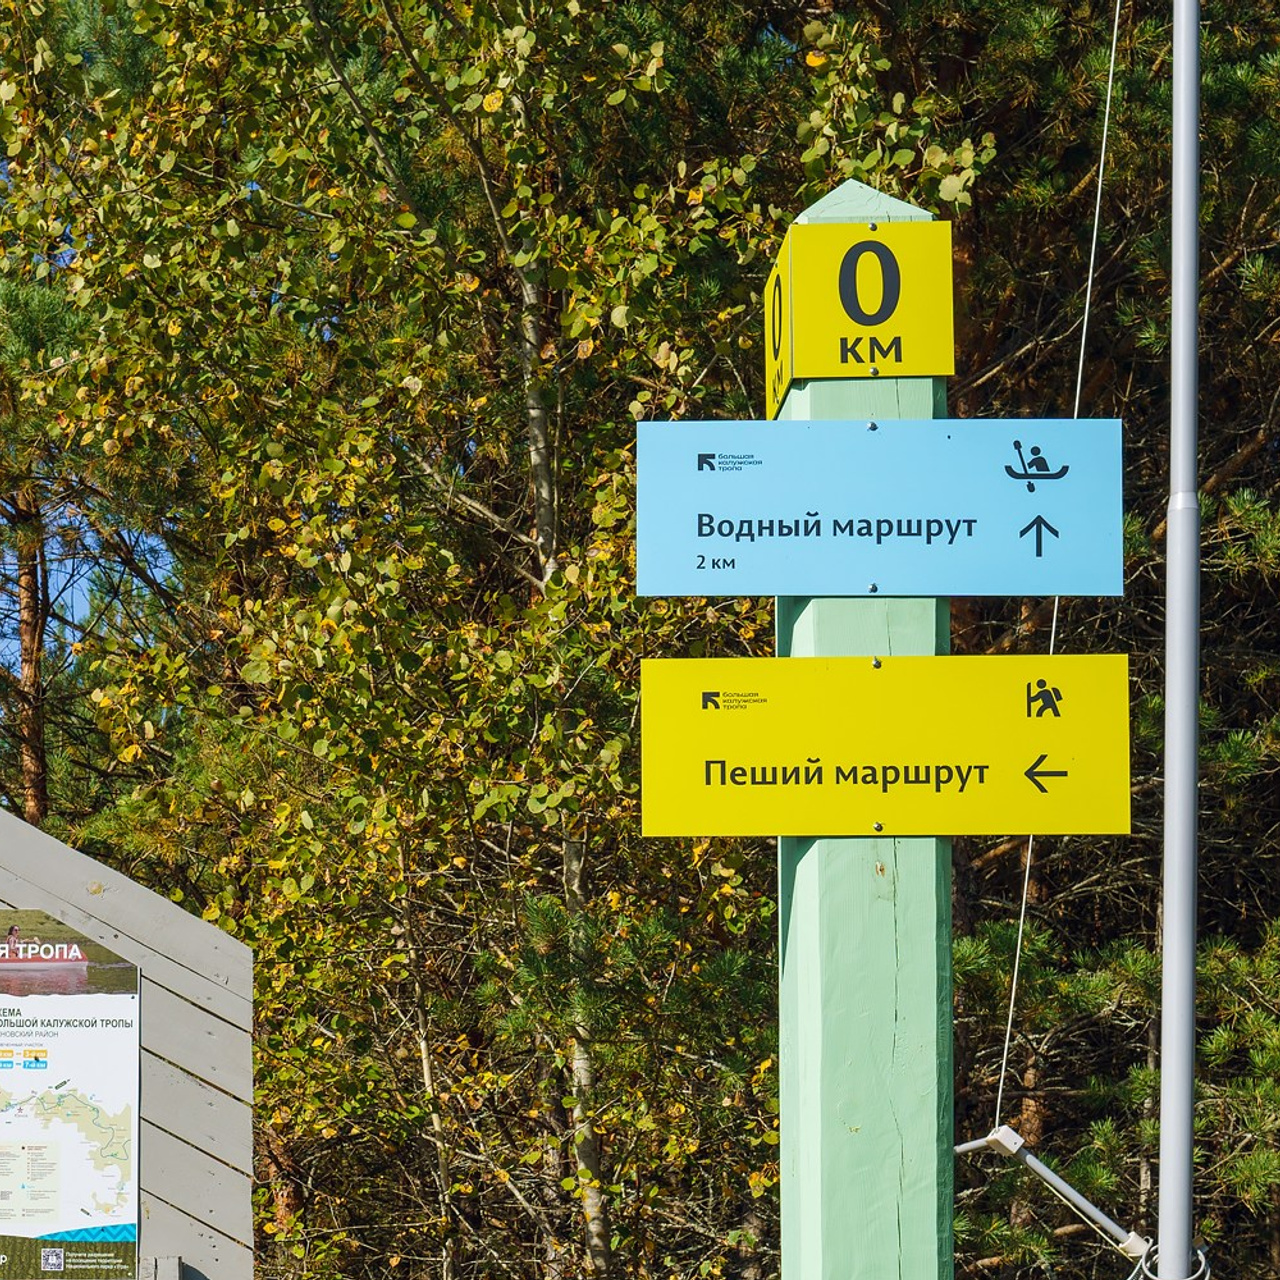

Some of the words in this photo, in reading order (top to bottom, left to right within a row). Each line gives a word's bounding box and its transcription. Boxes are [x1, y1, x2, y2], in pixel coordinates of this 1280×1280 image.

[838, 240, 901, 327] 0
[697, 510, 821, 543] Водный
[832, 518, 978, 545] маршрут
[696, 554, 706, 570] 2
[711, 557, 736, 570] км
[704, 756, 823, 786] Пеший
[835, 764, 990, 793] маршрут
[17, 943, 83, 960] ТРОПА
[40, 1017, 97, 1028] КАЛУЖСКОЙ
[99, 1018, 133, 1028] ТРОПЫ
[34, 1030, 59, 1038] РАЙОН
